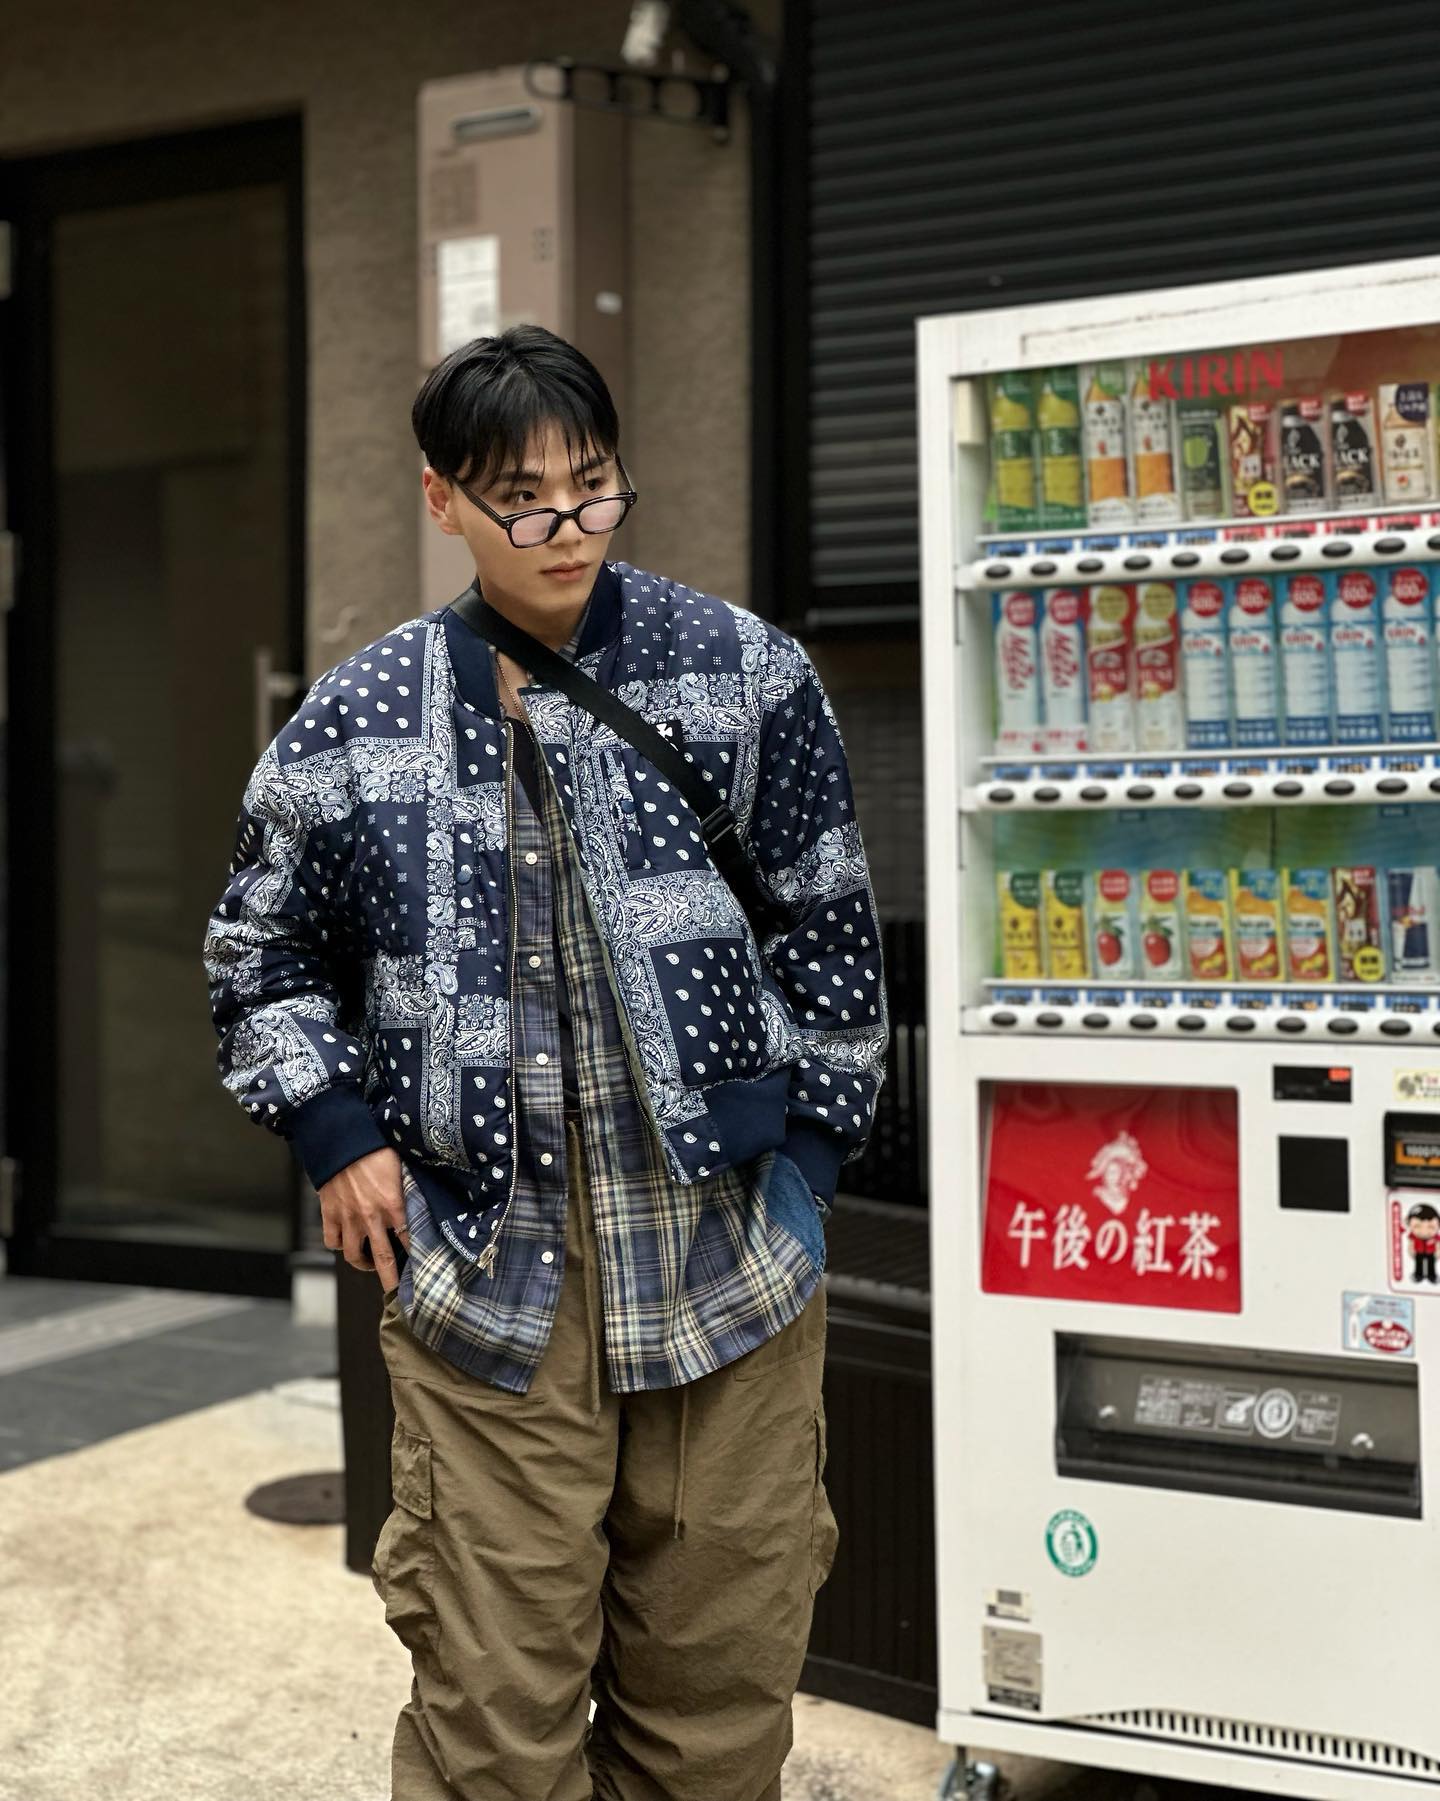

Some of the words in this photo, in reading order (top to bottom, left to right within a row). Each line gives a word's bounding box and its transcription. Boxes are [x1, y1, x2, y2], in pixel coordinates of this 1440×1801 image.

[1148, 348, 1283, 399] KIRIN
[1008, 1200, 1221, 1280] 午後の紅茶
